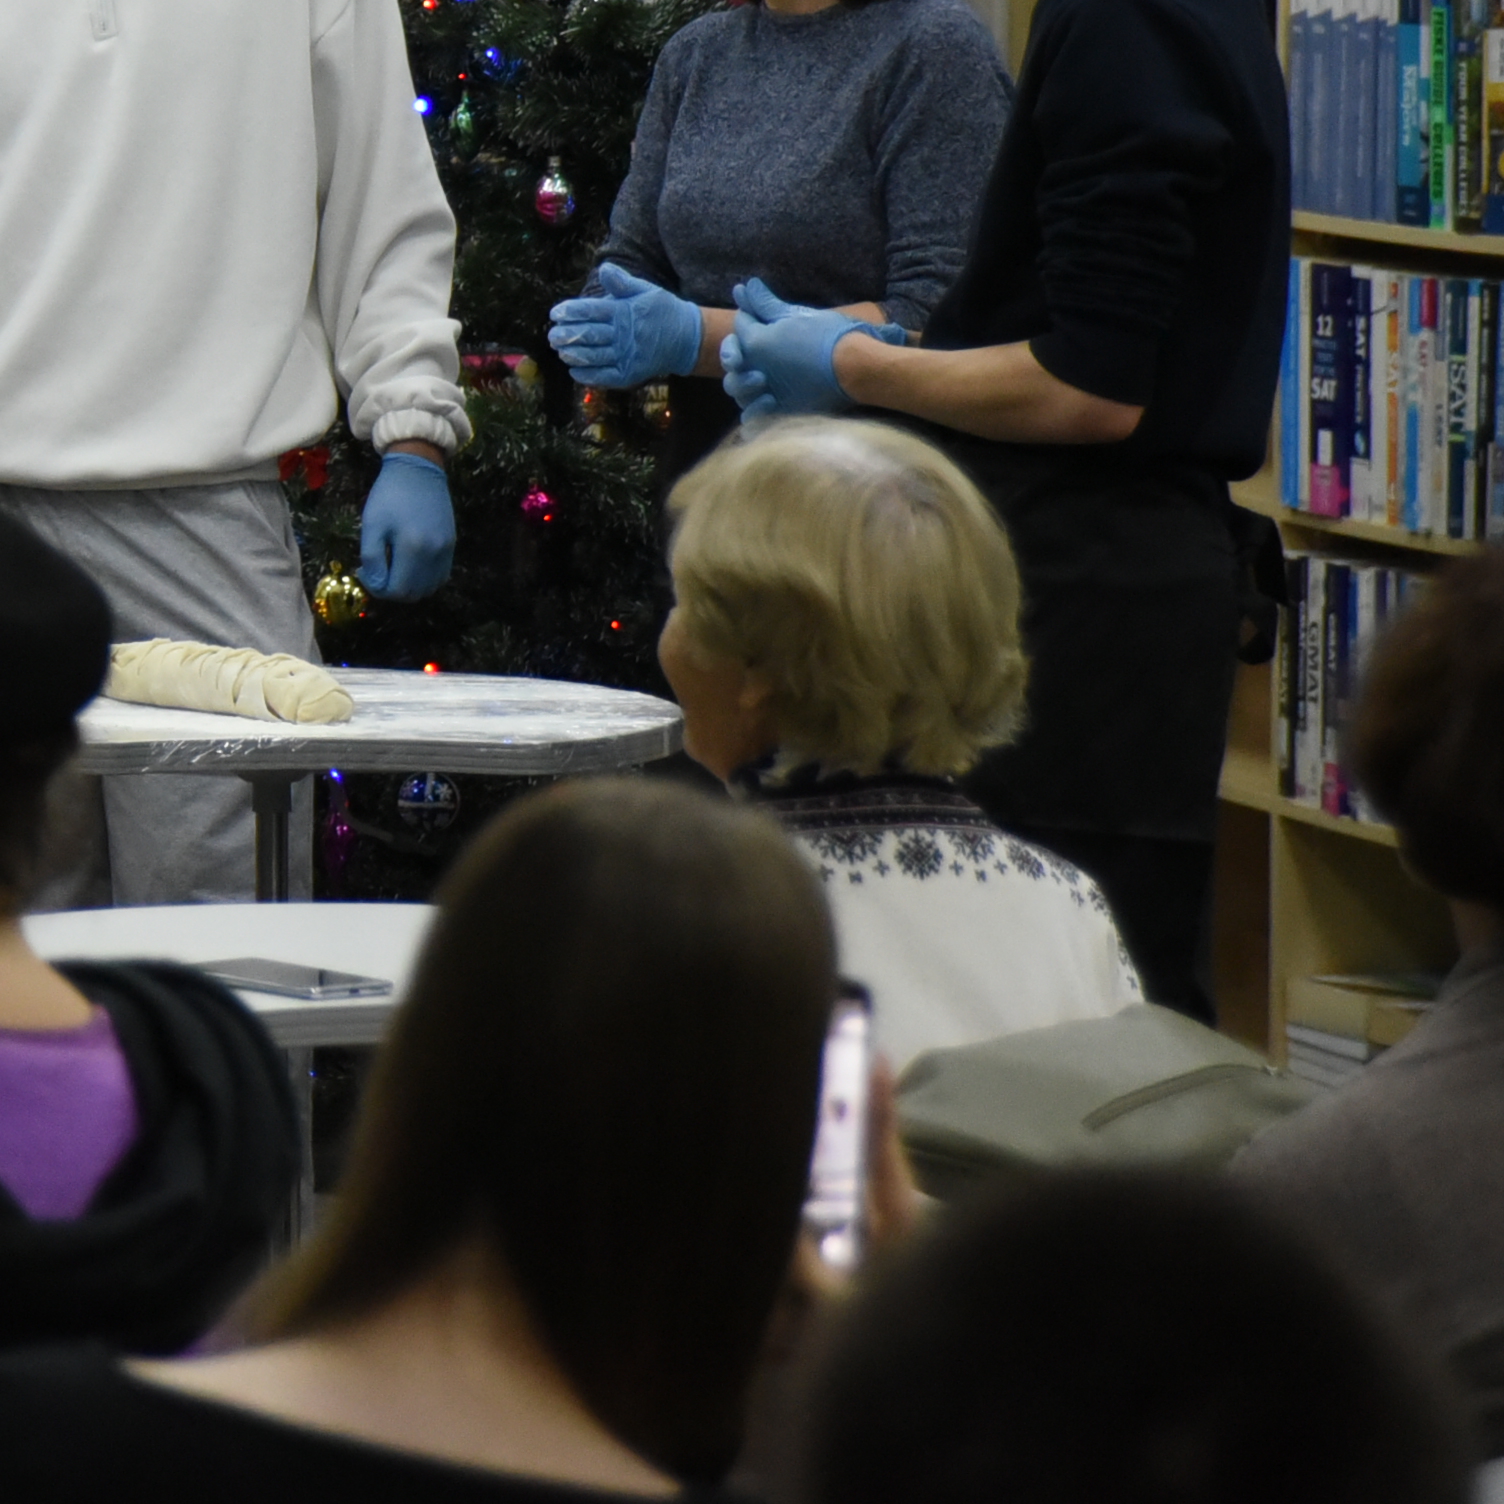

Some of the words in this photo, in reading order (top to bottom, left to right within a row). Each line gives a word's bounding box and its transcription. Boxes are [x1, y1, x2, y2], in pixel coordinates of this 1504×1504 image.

[1316, 314, 1334, 337] 12
[1355, 314, 1368, 360] SAT
[1311, 376, 1338, 402] SAT
[1448, 362, 1468, 432] SAT
[1307, 621, 1319, 704] GMAT
